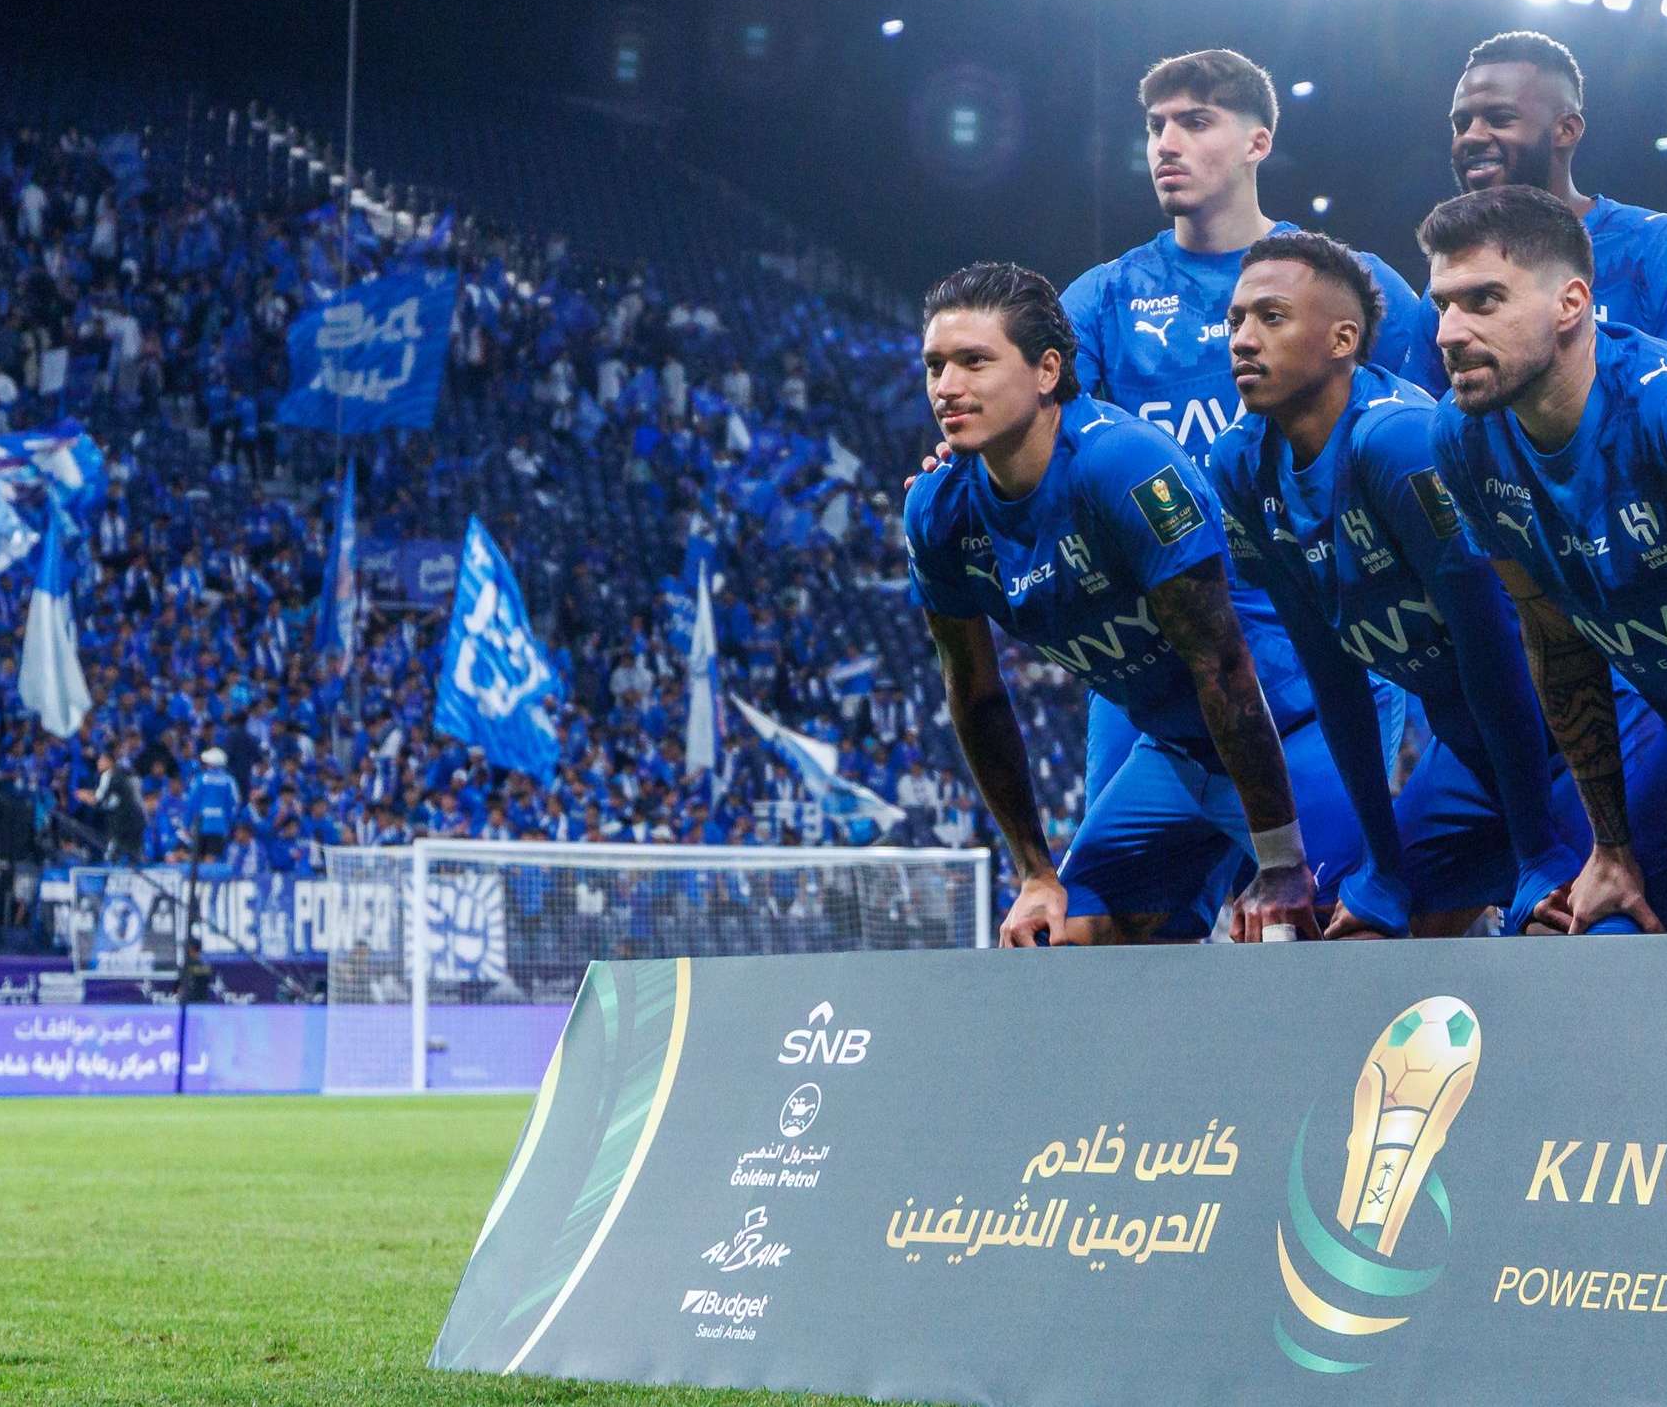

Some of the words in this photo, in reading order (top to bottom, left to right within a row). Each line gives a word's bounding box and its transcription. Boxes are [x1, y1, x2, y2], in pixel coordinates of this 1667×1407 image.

[1130, 295, 1180, 312] flynas
[1112, 640, 1172, 680] GROU
[293, 879, 394, 953] POWER
[778, 1029, 871, 1065] SNB
[1022, 1122, 1126, 1183] خادم
[1135, 1118, 1240, 1181] كأس
[730, 1168, 776, 1187] Golden
[777, 1169, 821, 1188] Petrol
[886, 1193, 1068, 1266] الشريفين
[1068, 1202, 1221, 1272] الحرمين
[702, 1291, 769, 1324] Budget
[695, 1323, 724, 1337] Saudi
[723, 1325, 757, 1341] Arabia
